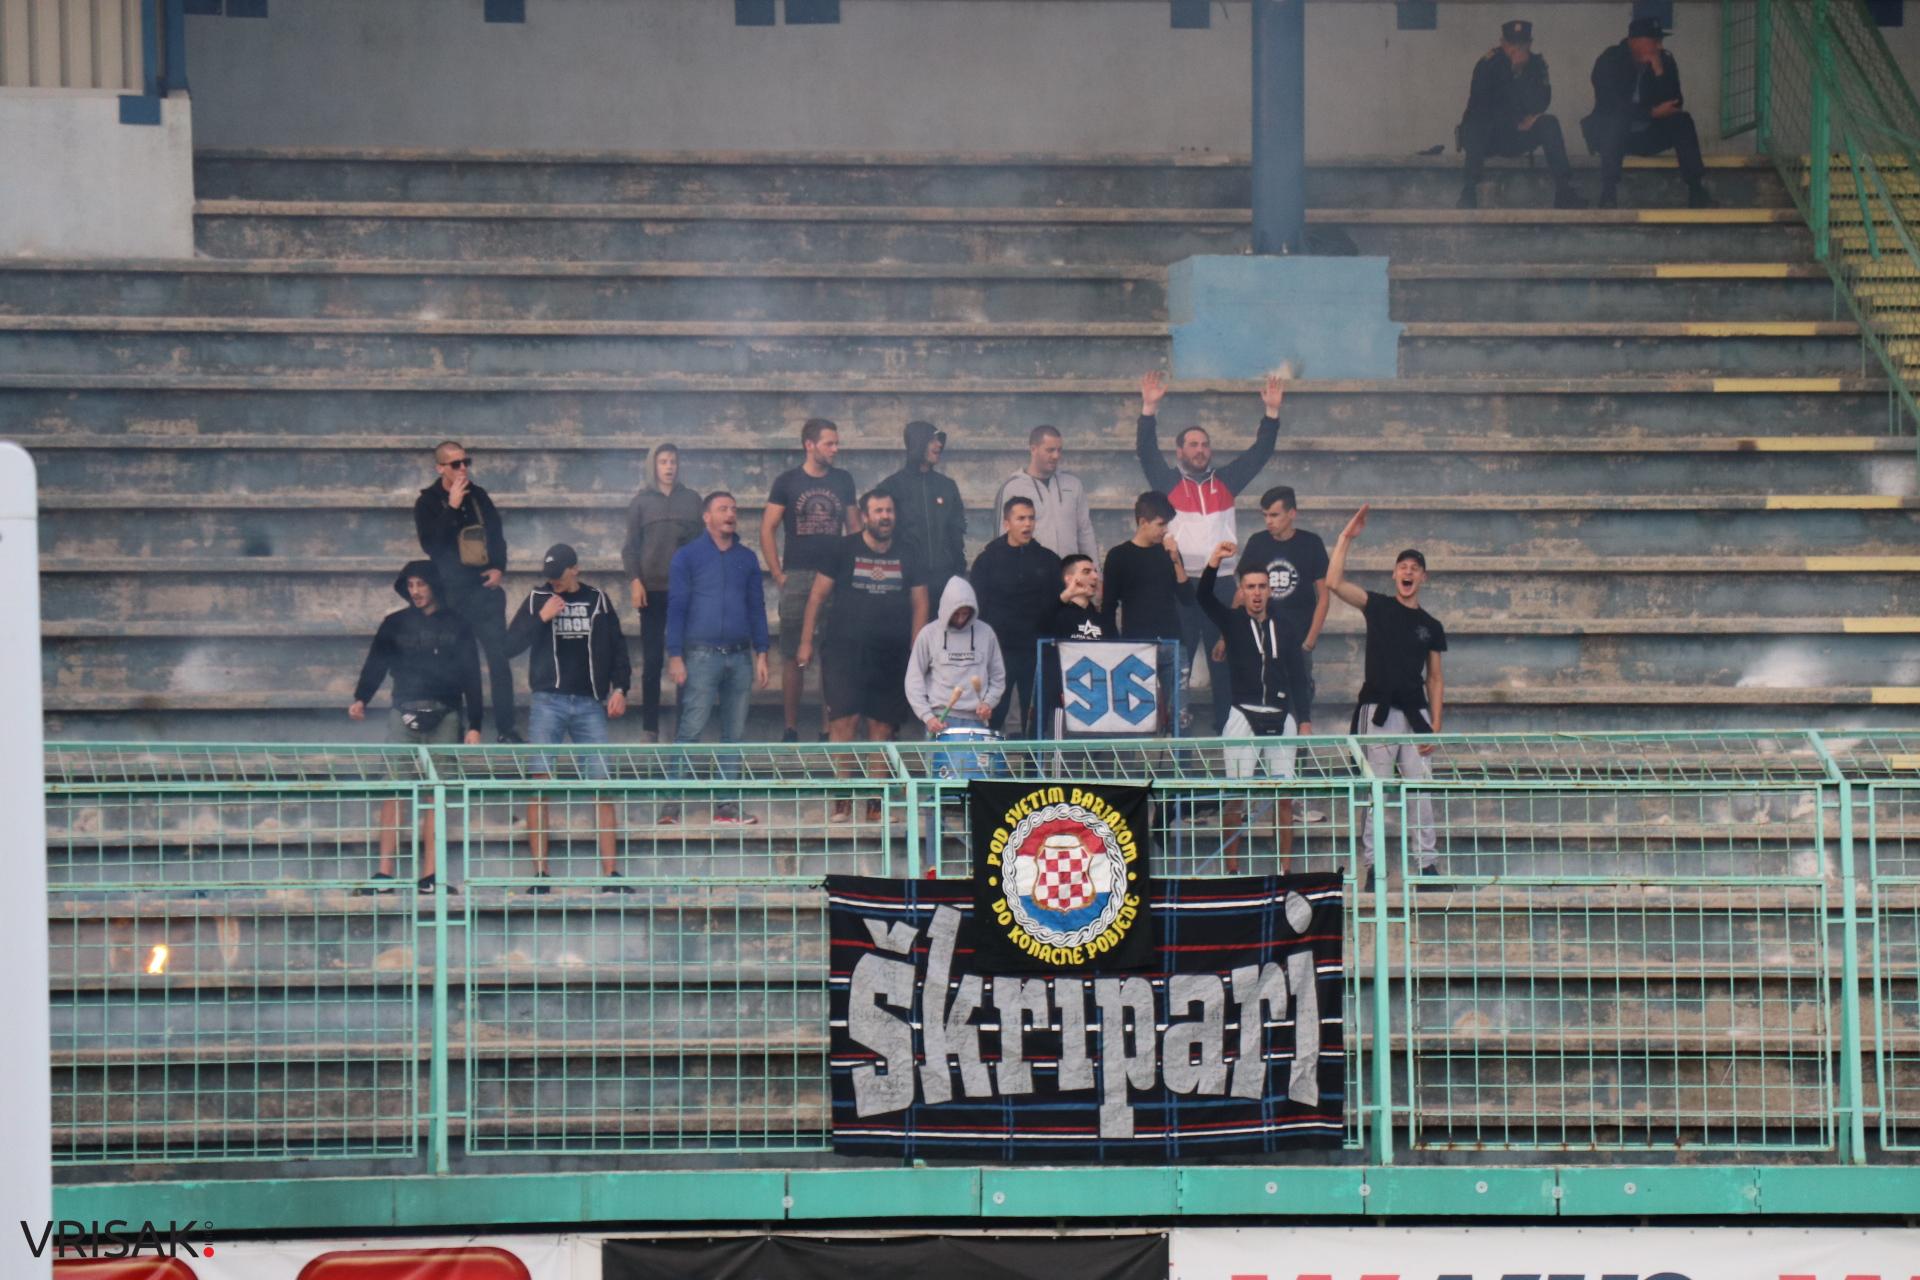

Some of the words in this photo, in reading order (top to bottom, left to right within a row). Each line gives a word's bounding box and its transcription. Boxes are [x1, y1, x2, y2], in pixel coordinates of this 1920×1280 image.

[1065, 654, 1156, 727] 96
[986, 827, 1009, 866] POD
[1004, 786, 1065, 828] SVETIM
[1070, 788, 1139, 864] BARJAKOM
[991, 898, 1012, 926] DO
[1085, 892, 1141, 960] POBJEDE
